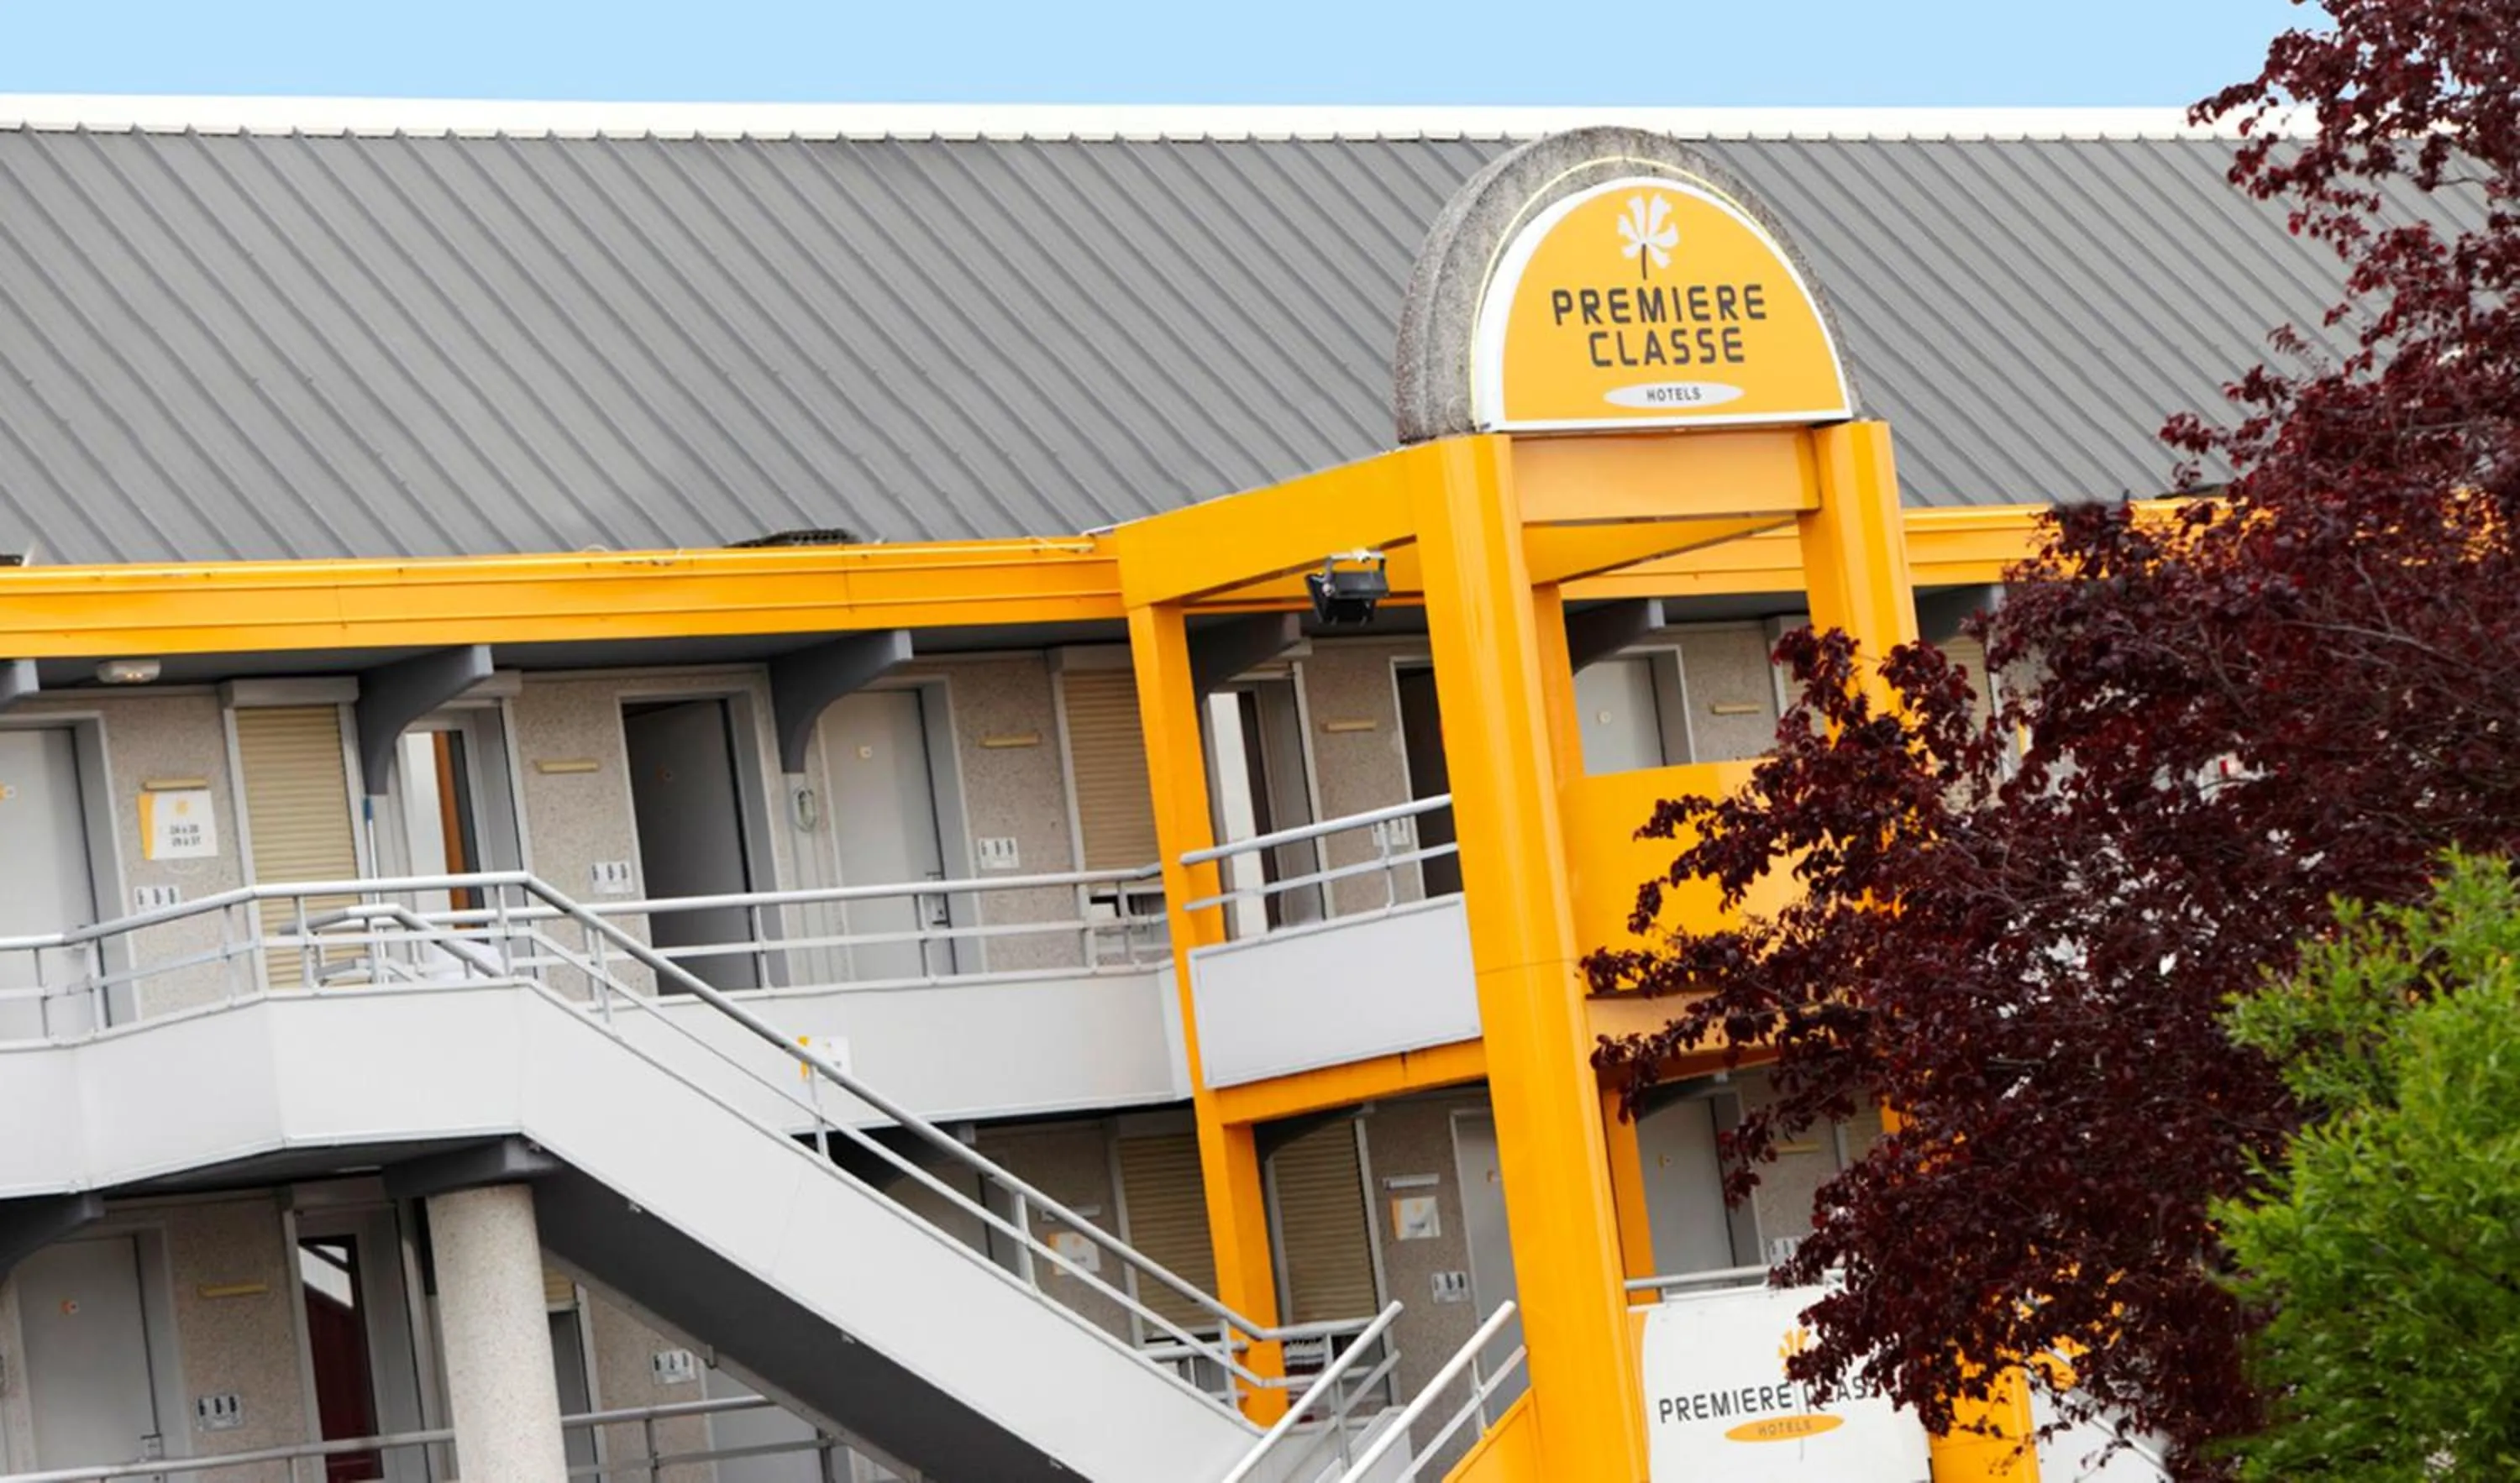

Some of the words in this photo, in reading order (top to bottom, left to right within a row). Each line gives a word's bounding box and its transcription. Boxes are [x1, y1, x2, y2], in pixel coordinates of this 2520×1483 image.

[1551, 284, 1767, 326] PREMIERE
[1588, 327, 1745, 367] CLASSE
[1646, 386, 1701, 402] HOTELS
[1659, 1383, 1793, 1423] PREMIERE
[1758, 1419, 1812, 1437] HOTELS
